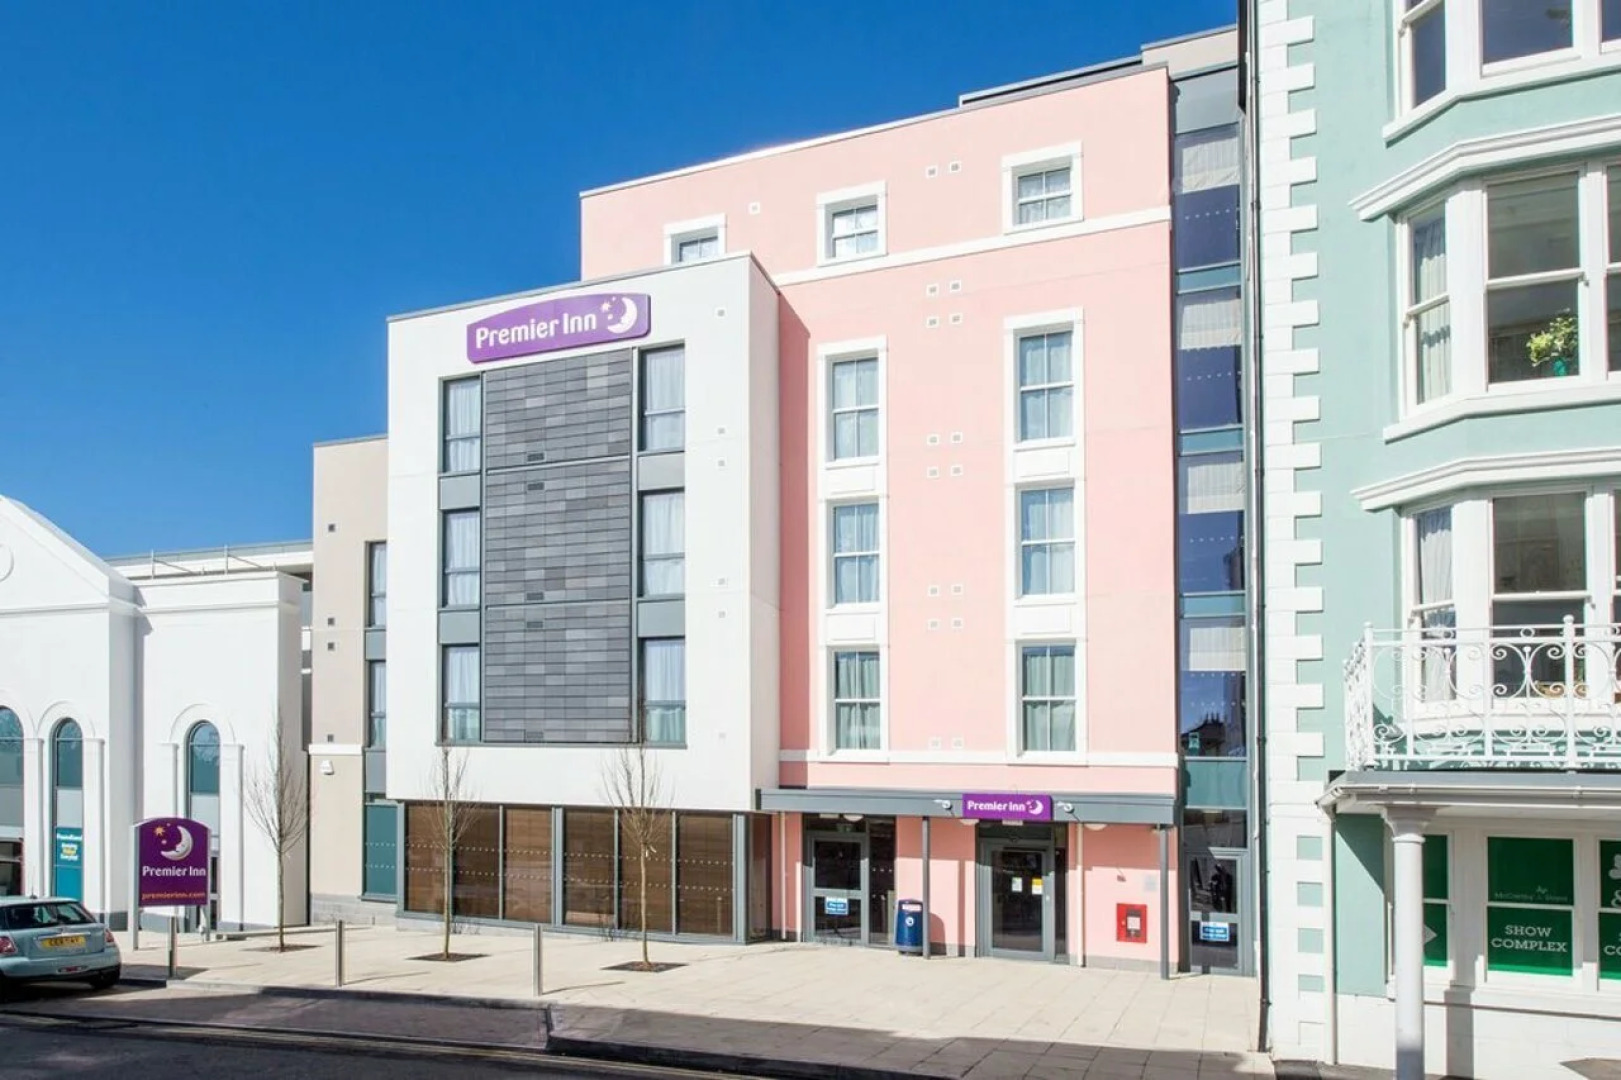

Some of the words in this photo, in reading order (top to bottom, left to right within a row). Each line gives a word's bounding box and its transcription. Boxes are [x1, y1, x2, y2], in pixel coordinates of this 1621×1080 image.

[475, 318, 560, 349] Premier
[563, 313, 597, 334] Inn
[967, 800, 1007, 811] Premier
[1009, 801, 1026, 811] Inn
[142, 865, 188, 877] Premier
[189, 866, 206, 877] Inn
[142, 892, 206, 901] premierinn.com
[1505, 924, 1552, 937] SHOW
[1491, 938, 1567, 953] COMPLEX
